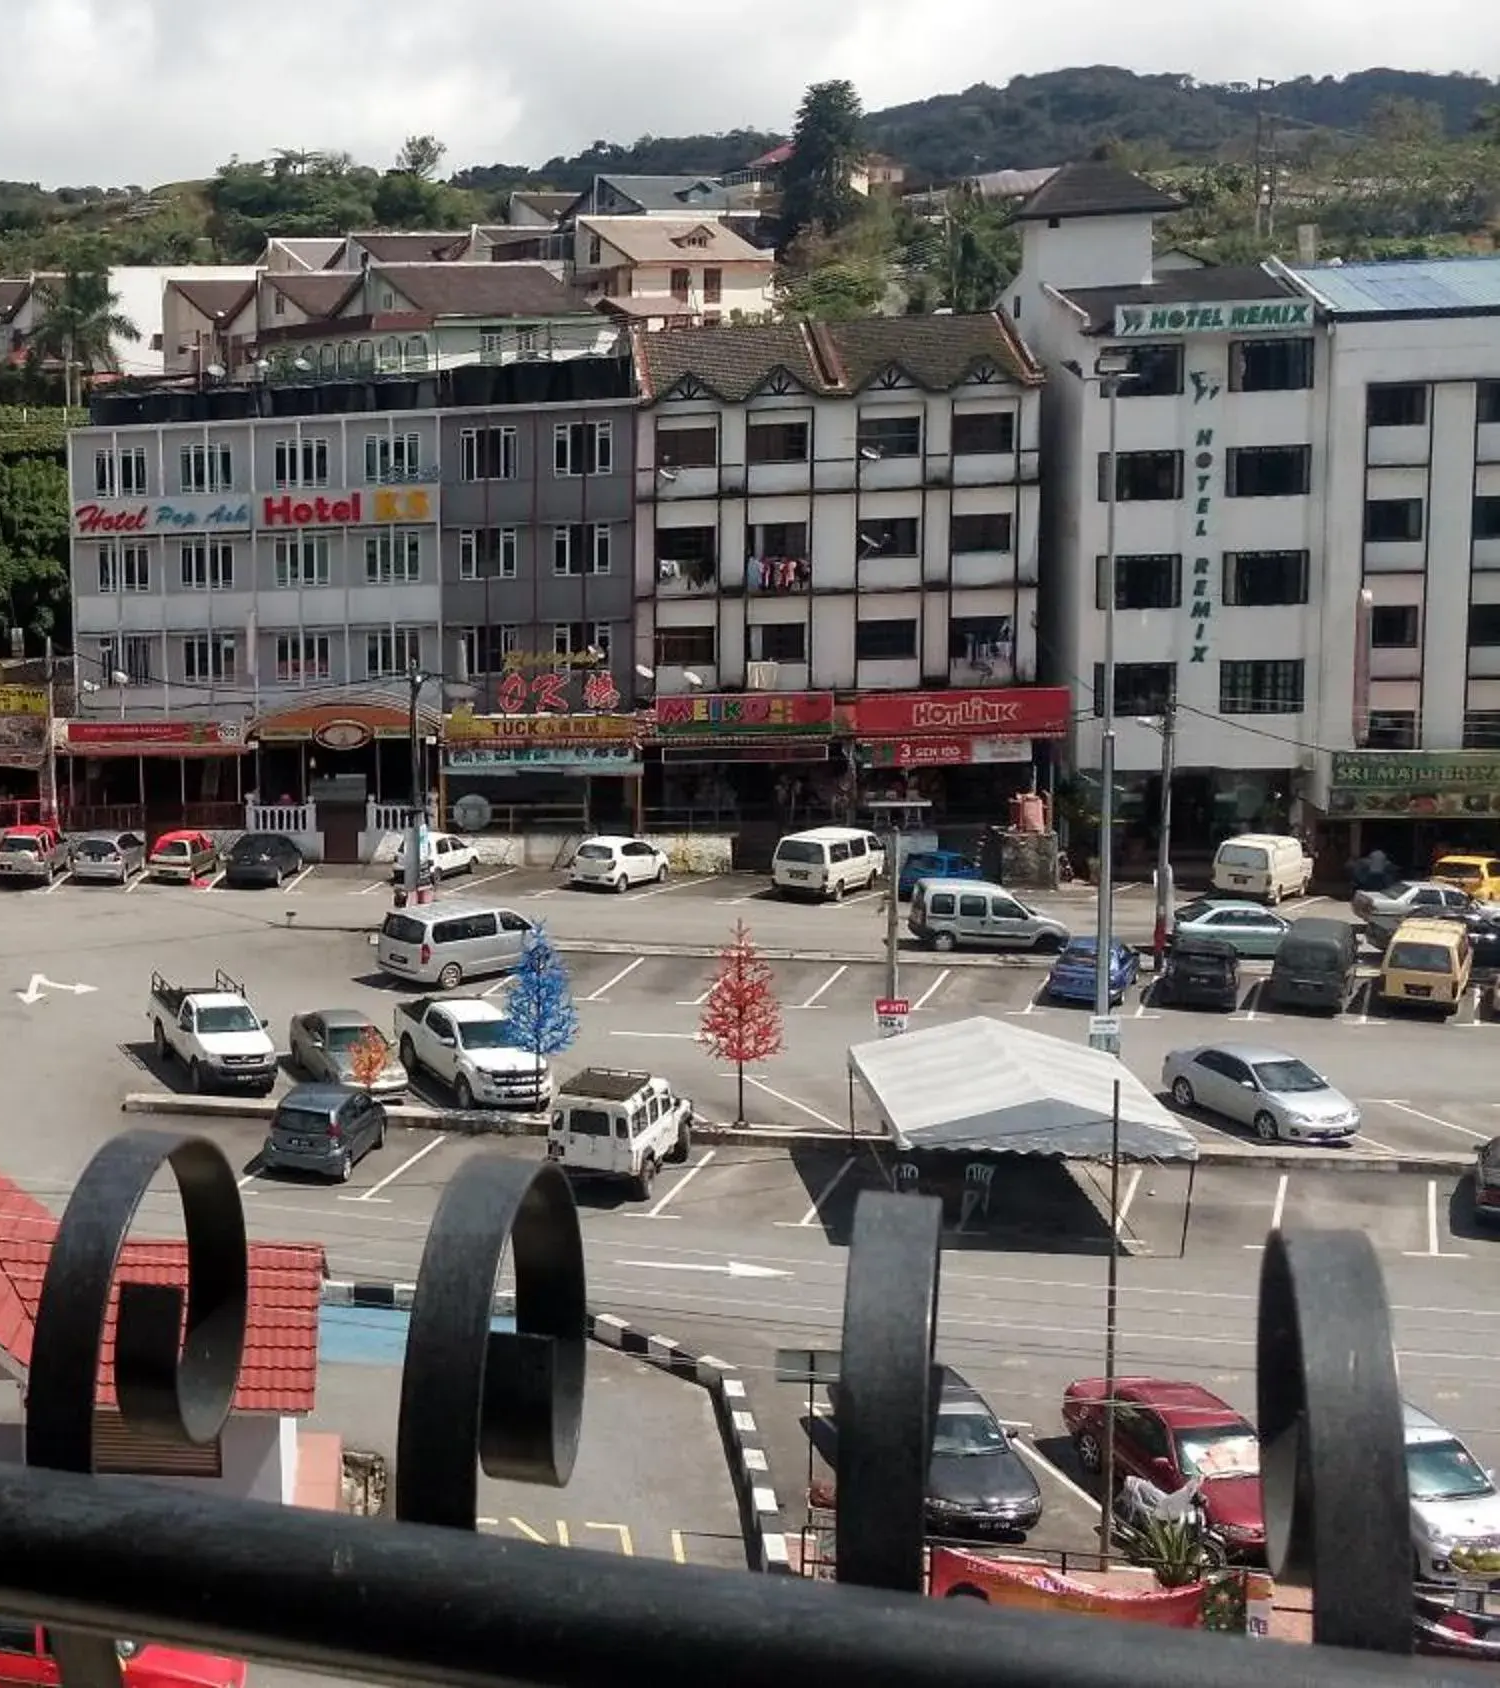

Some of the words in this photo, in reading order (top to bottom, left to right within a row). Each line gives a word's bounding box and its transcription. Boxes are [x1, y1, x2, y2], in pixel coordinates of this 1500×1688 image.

[1150, 308, 1224, 329] HOTEL
[1230, 304, 1311, 326] REMIX
[1194, 428, 1214, 536] HOTEL
[75, 503, 149, 533] Hotel
[263, 491, 361, 525] Hotel
[1189, 557, 1212, 663] REMIX
[492, 721, 539, 737] TUCK
[901, 743, 912, 758] 3
[1337, 766, 1369, 781] SRI
